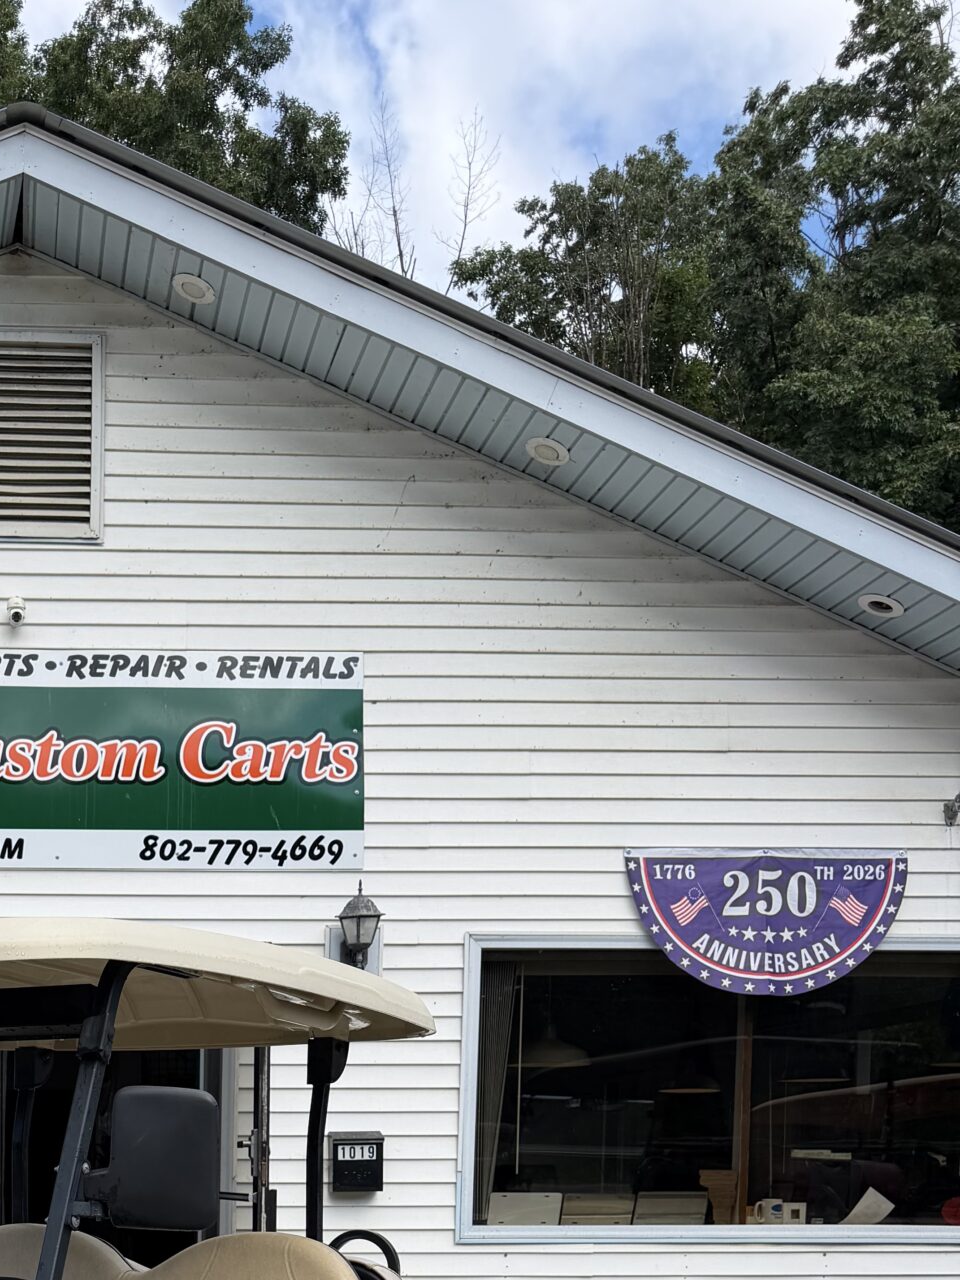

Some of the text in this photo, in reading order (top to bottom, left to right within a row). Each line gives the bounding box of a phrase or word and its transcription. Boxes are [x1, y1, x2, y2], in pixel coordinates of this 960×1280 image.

[65, 654, 188, 680] REPAIR
[216, 656, 360, 680] RENTALS
[180, 720, 359, 784] Carts
[139, 835, 344, 867] 802-779-4669
[653, 864, 696, 880] 1776
[843, 864, 885, 881] 2026
[692, 933, 840, 973] ANNIVERSARY
[341, 1146, 375, 1159] 1019
